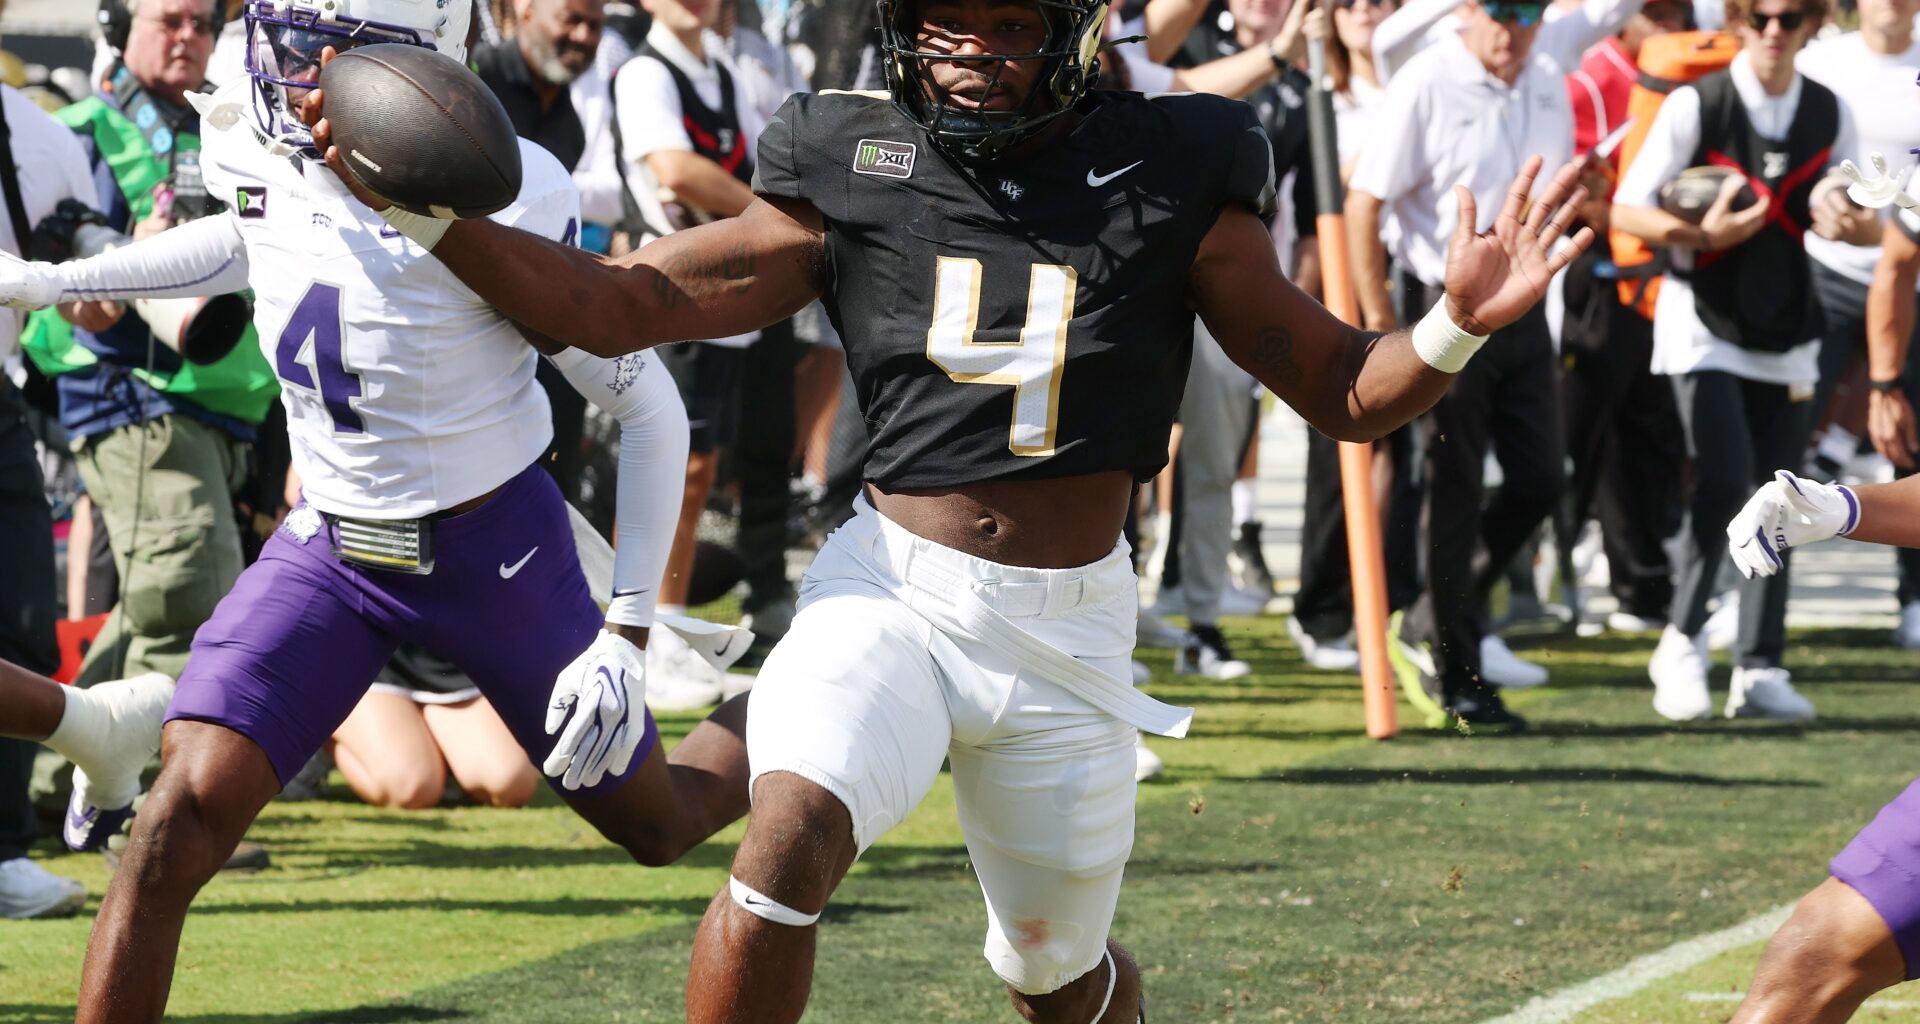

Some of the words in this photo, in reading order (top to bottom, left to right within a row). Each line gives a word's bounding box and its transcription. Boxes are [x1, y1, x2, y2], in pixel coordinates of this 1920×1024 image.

[878, 151, 908, 167] XII
[1001, 180, 1024, 199] UCF
[312, 213, 332, 228] TCU
[275, 278, 368, 439] 4
[927, 256, 1078, 457] 4
